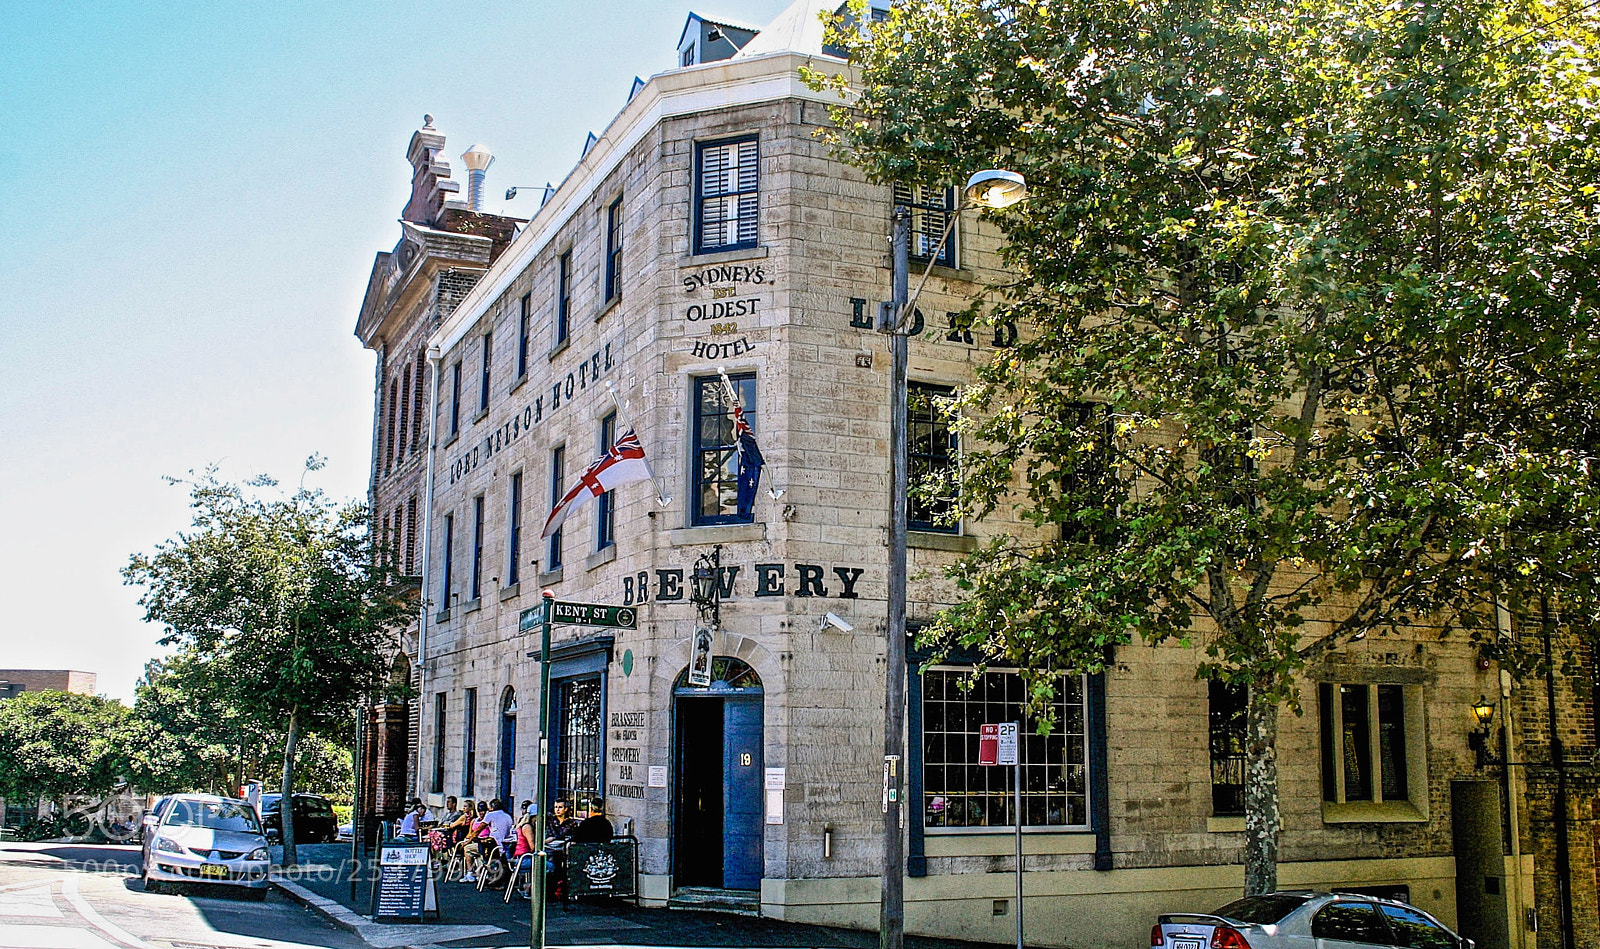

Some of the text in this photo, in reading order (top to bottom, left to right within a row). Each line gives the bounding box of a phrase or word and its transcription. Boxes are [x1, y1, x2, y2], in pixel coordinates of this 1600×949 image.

[683, 266, 765, 293] SYDNEY'S
[686, 298, 761, 322] OLDEST
[710, 322, 738, 335] 1842
[691, 337, 756, 360] HOTEL
[450, 446, 479, 485] LORD
[486, 395, 544, 459] NELSON
[556, 605, 588, 618] KENT
[593, 607, 608, 619] ST
[611, 712, 645, 727] BRASSERIE
[985, 726, 994, 734] NO
[1000, 725, 1016, 736] 2P
[612, 747, 641, 762] BREWERY
[740, 753, 752, 766] 19
[620, 766, 633, 780] BAR
